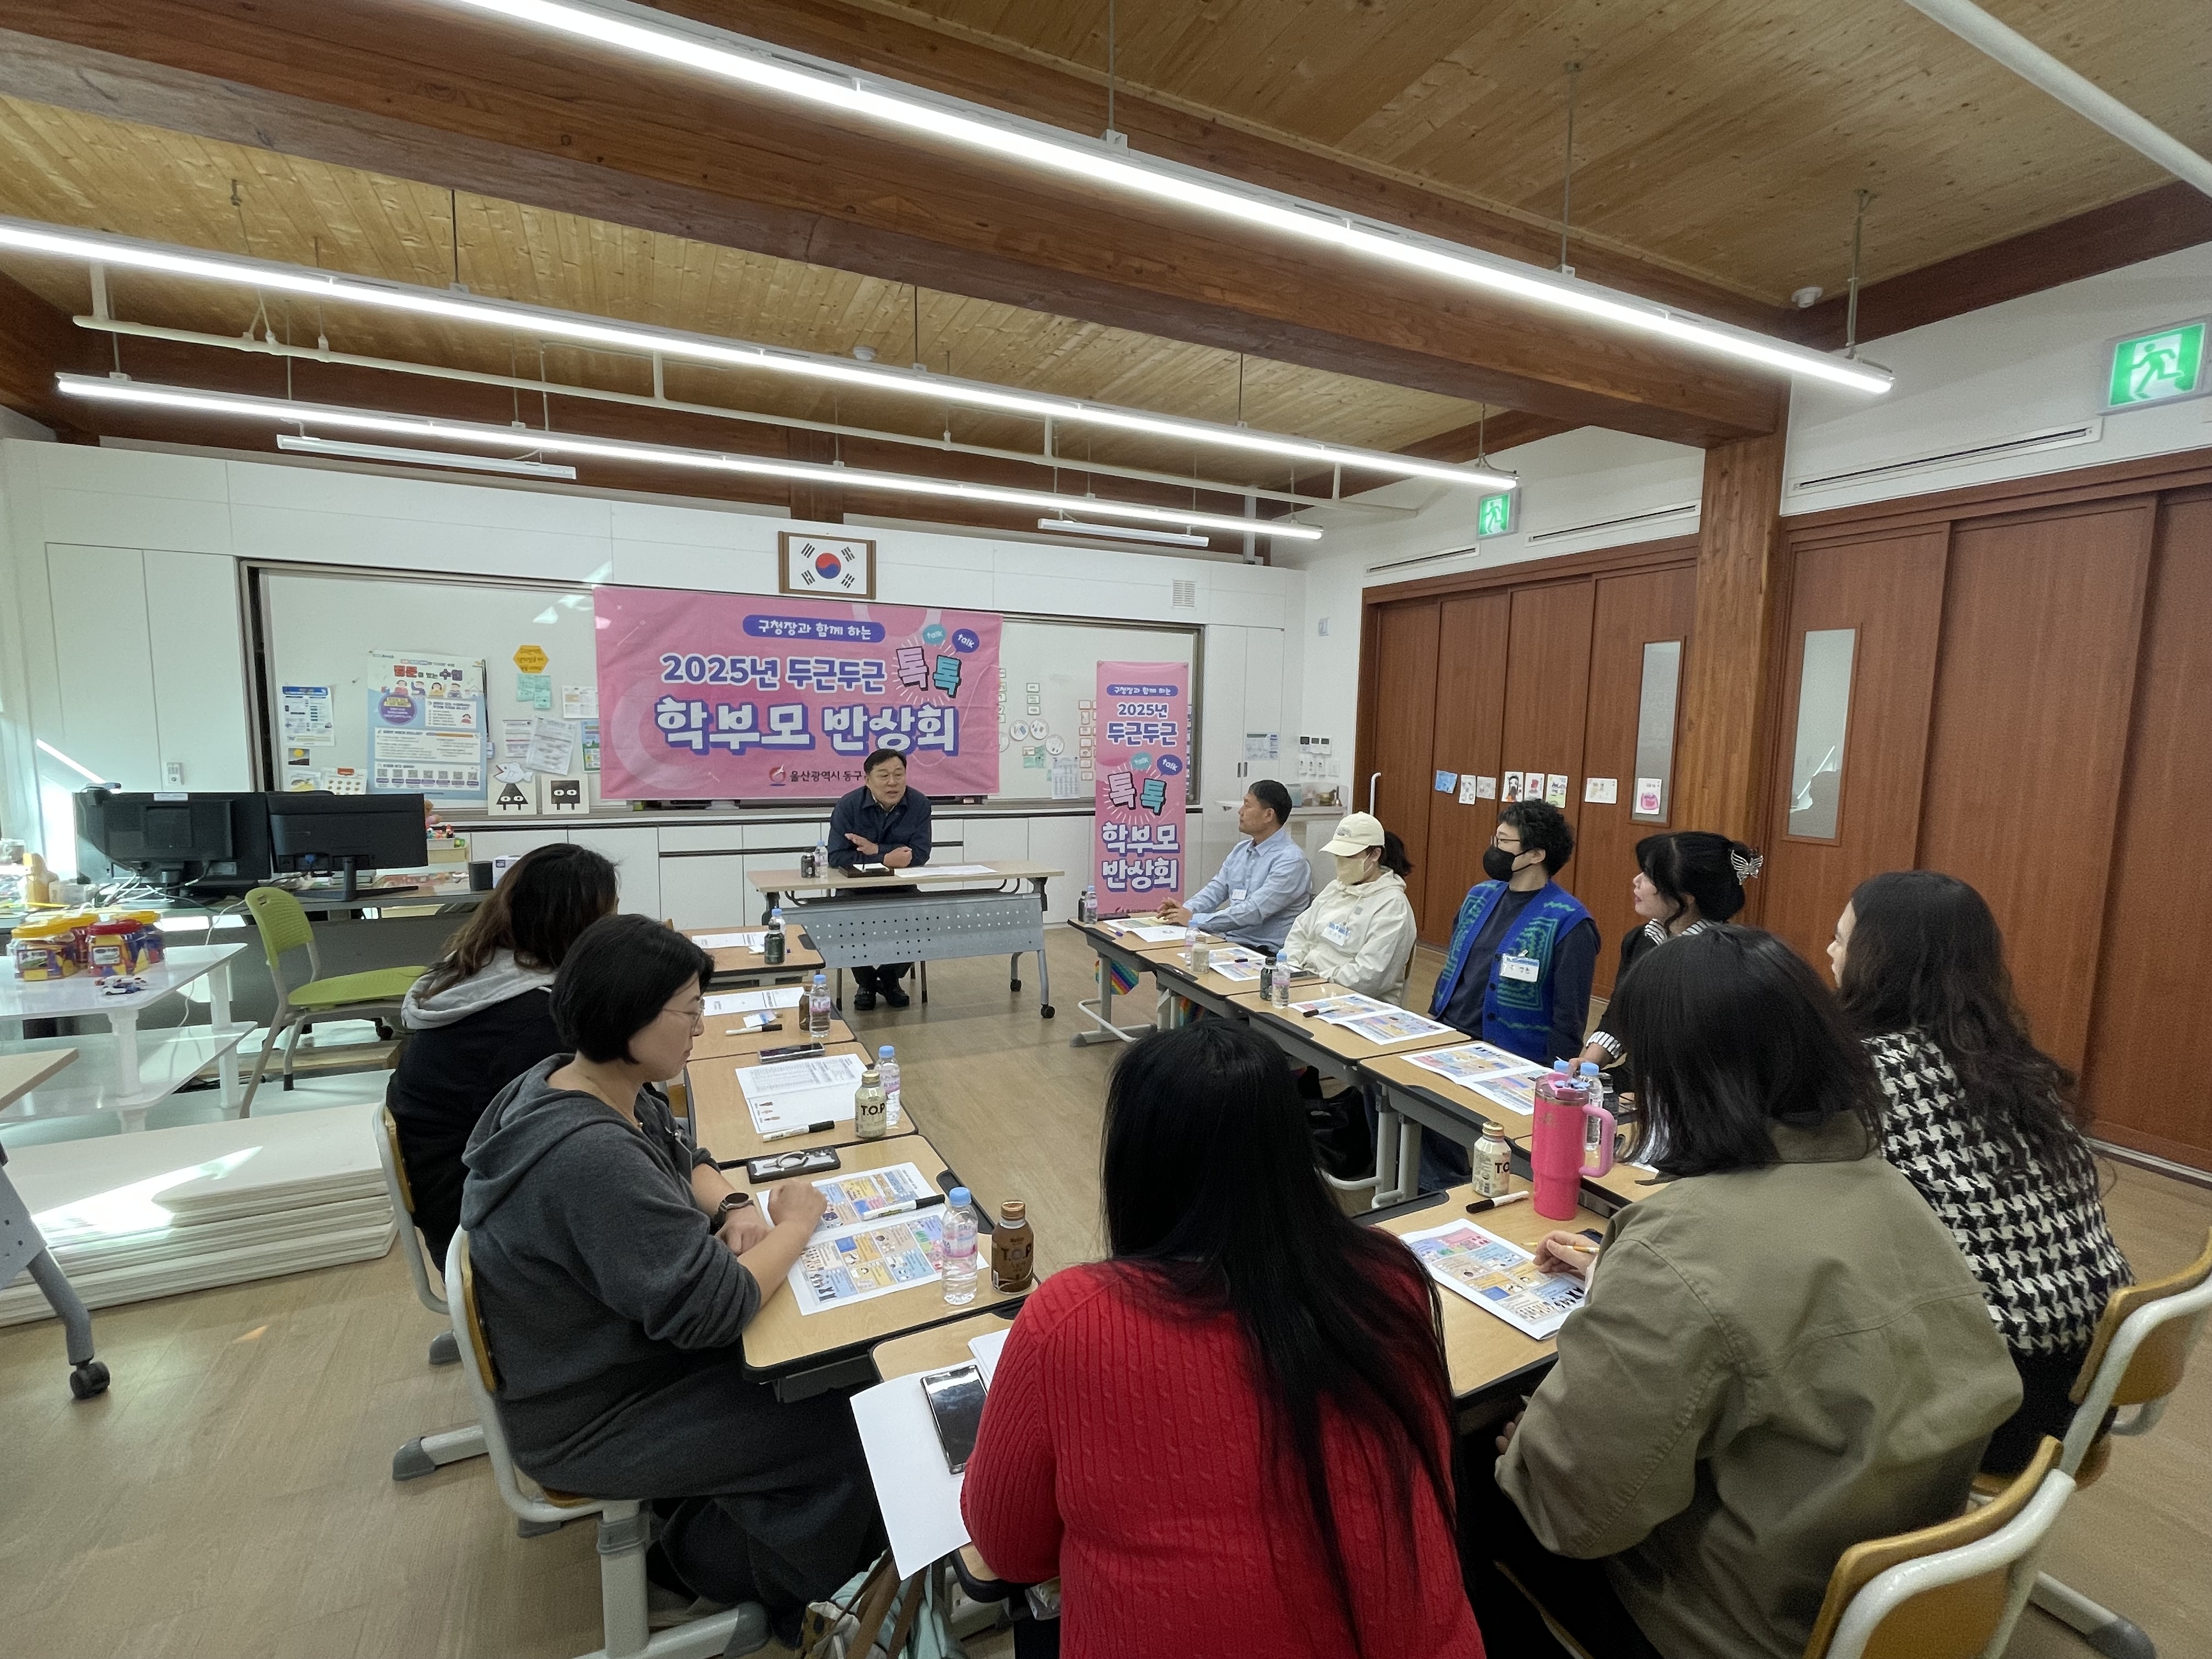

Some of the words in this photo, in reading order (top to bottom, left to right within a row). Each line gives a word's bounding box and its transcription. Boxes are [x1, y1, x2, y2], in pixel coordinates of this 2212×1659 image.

[758, 619, 812, 636] 구청장과
[815, 622, 843, 638] 함께
[847, 625, 872, 640] 하는
[926, 630, 943, 639] talk
[958, 634, 975, 648] talk
[661, 654, 778, 690] 2025년
[787, 657, 886, 693] 두근두근
[1118, 703, 1167, 718] 2025년
[656, 696, 814, 754] 학부모
[823, 703, 958, 755] 반상회
[1107, 722, 1178, 746] 두근두근
[1162, 758, 1178, 772] talk
[789, 770, 840, 782] 울산광역시
[843, 770, 862, 782] 동구
[1102, 821, 1180, 856] 학부모
[1102, 857, 1178, 892] 반상회
[860, 1102, 885, 1116] T.O.P
[1000, 1243, 1032, 1261] T.O.P
